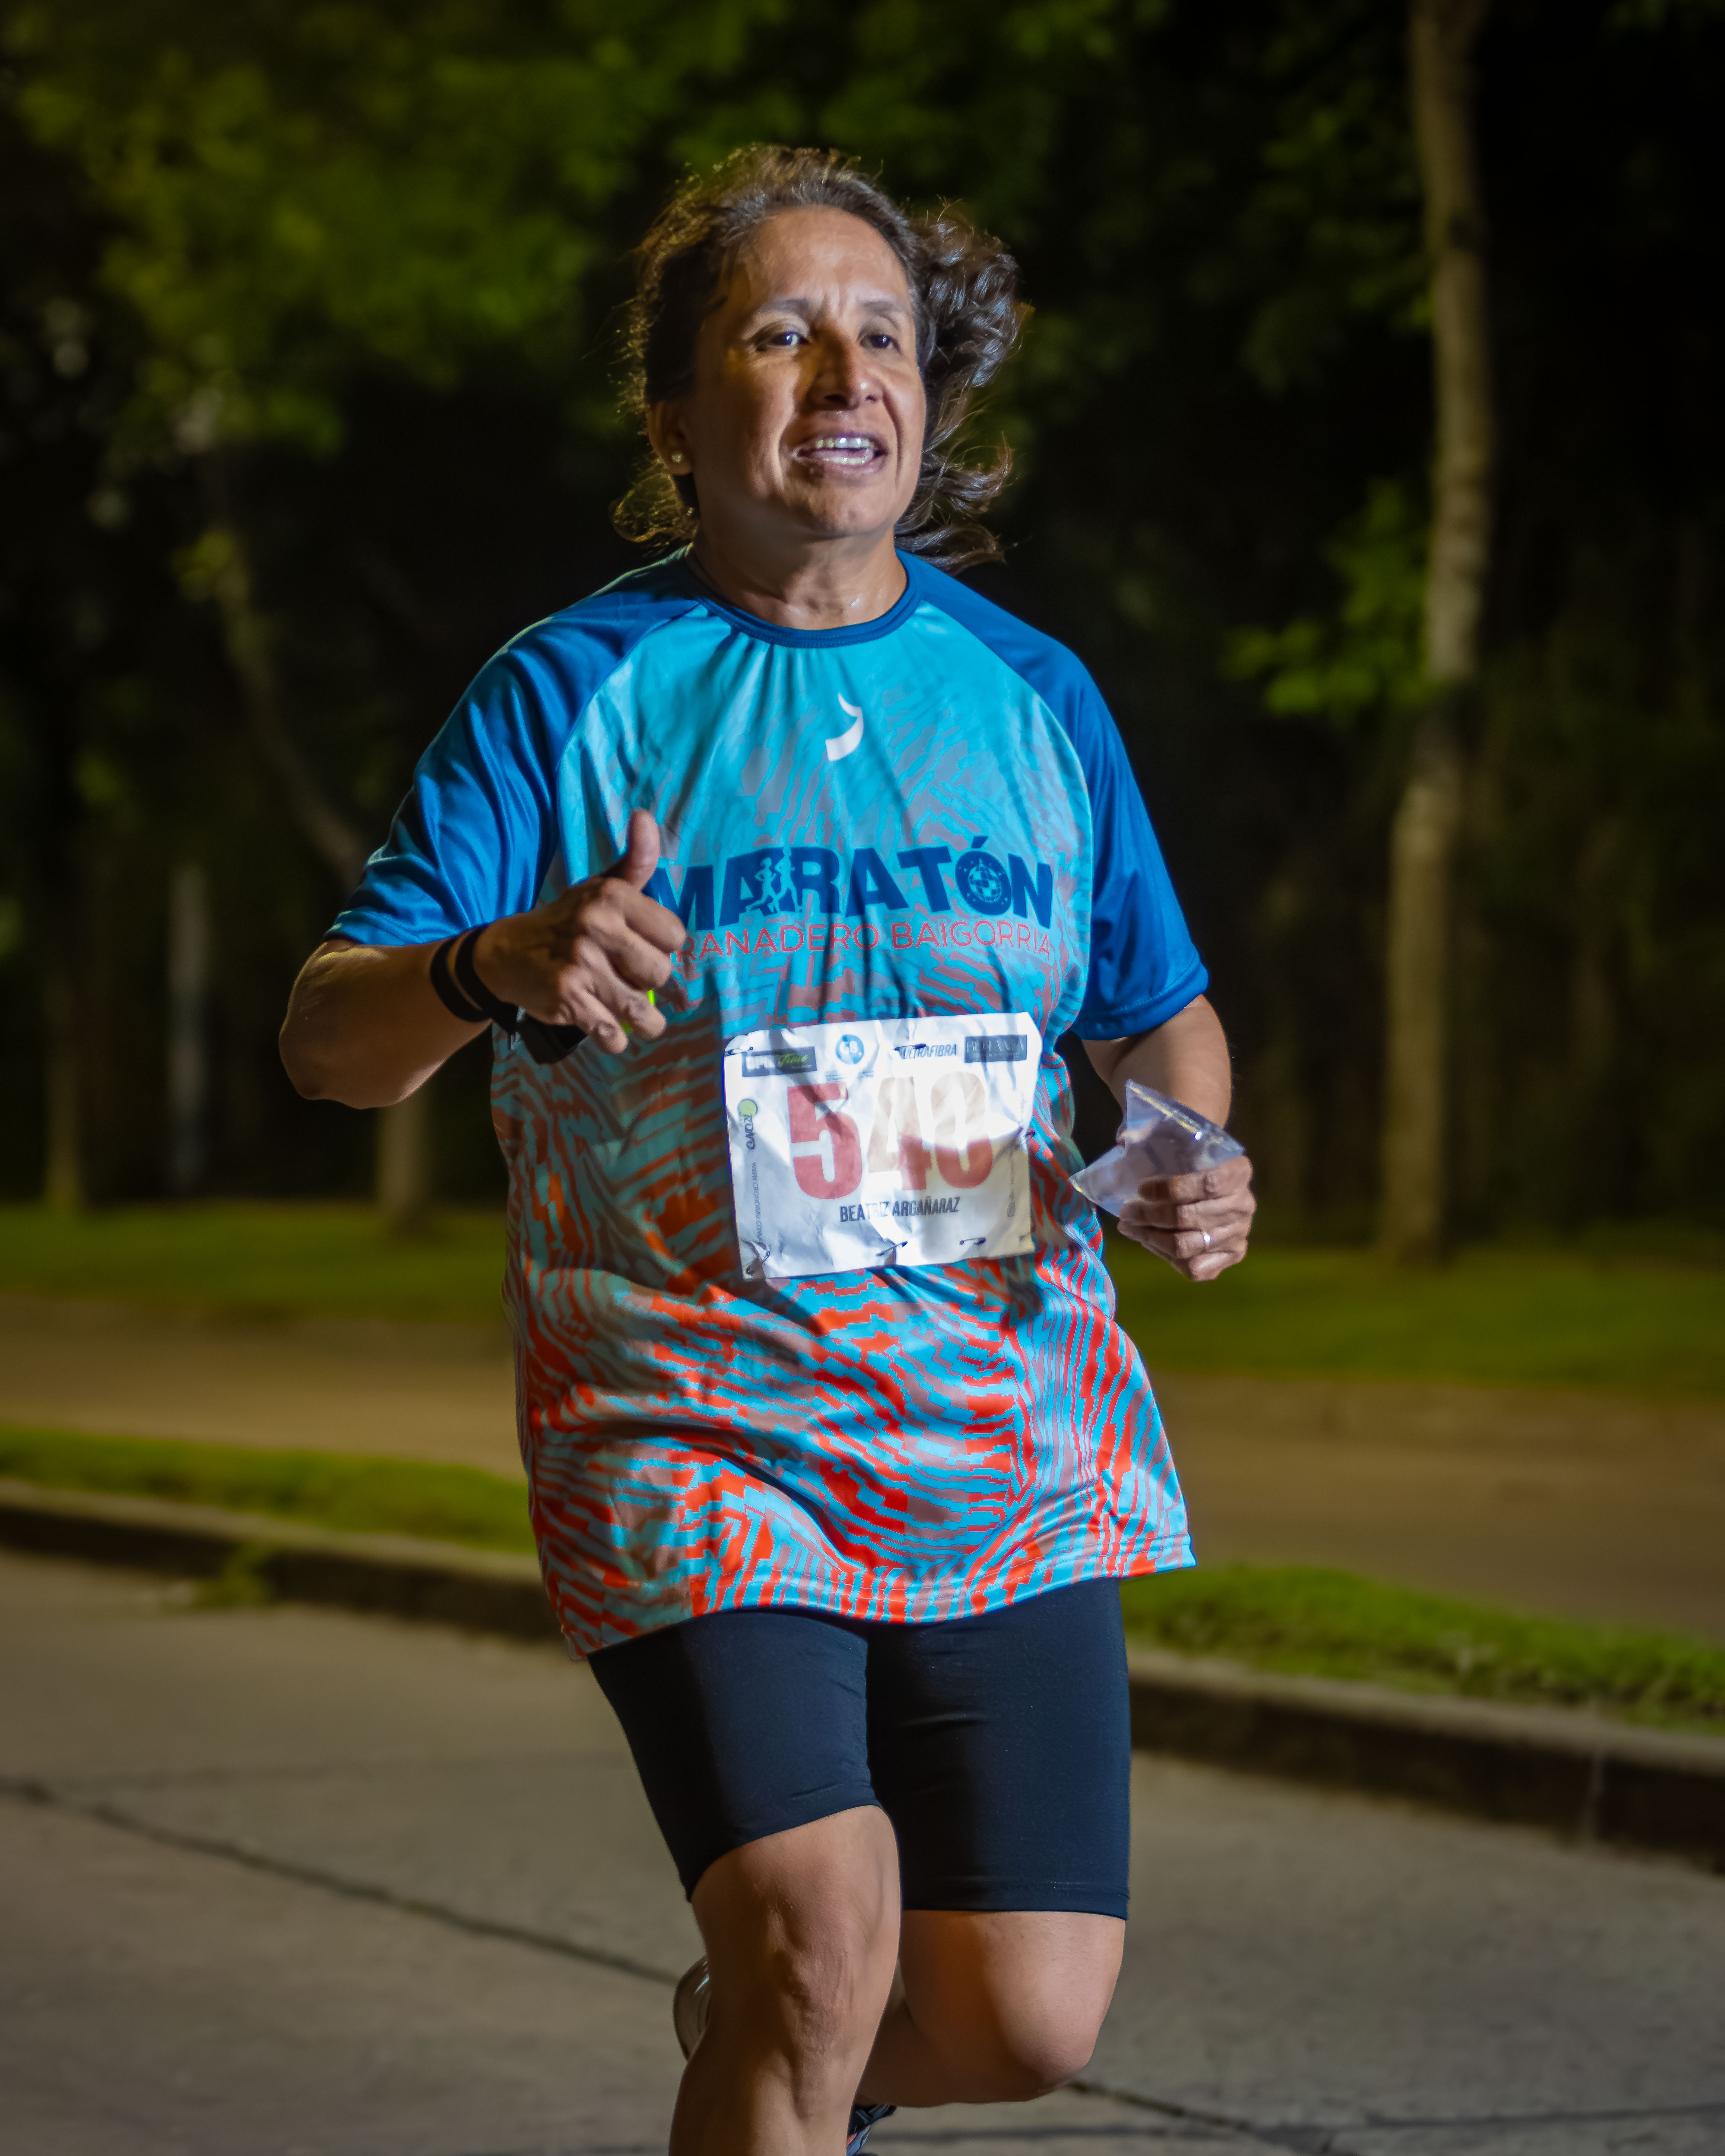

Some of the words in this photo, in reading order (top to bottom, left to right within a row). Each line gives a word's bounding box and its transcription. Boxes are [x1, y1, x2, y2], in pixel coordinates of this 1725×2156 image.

[643, 836, 1053, 930] MARATÓN
[667, 922, 879, 963] RANADERO
[891, 919, 1050, 961] BAIGORRIA
[839, 1200, 889, 1222] BEATRIZ
[892, 1196, 960, 1217] ARGAÑARAZ
